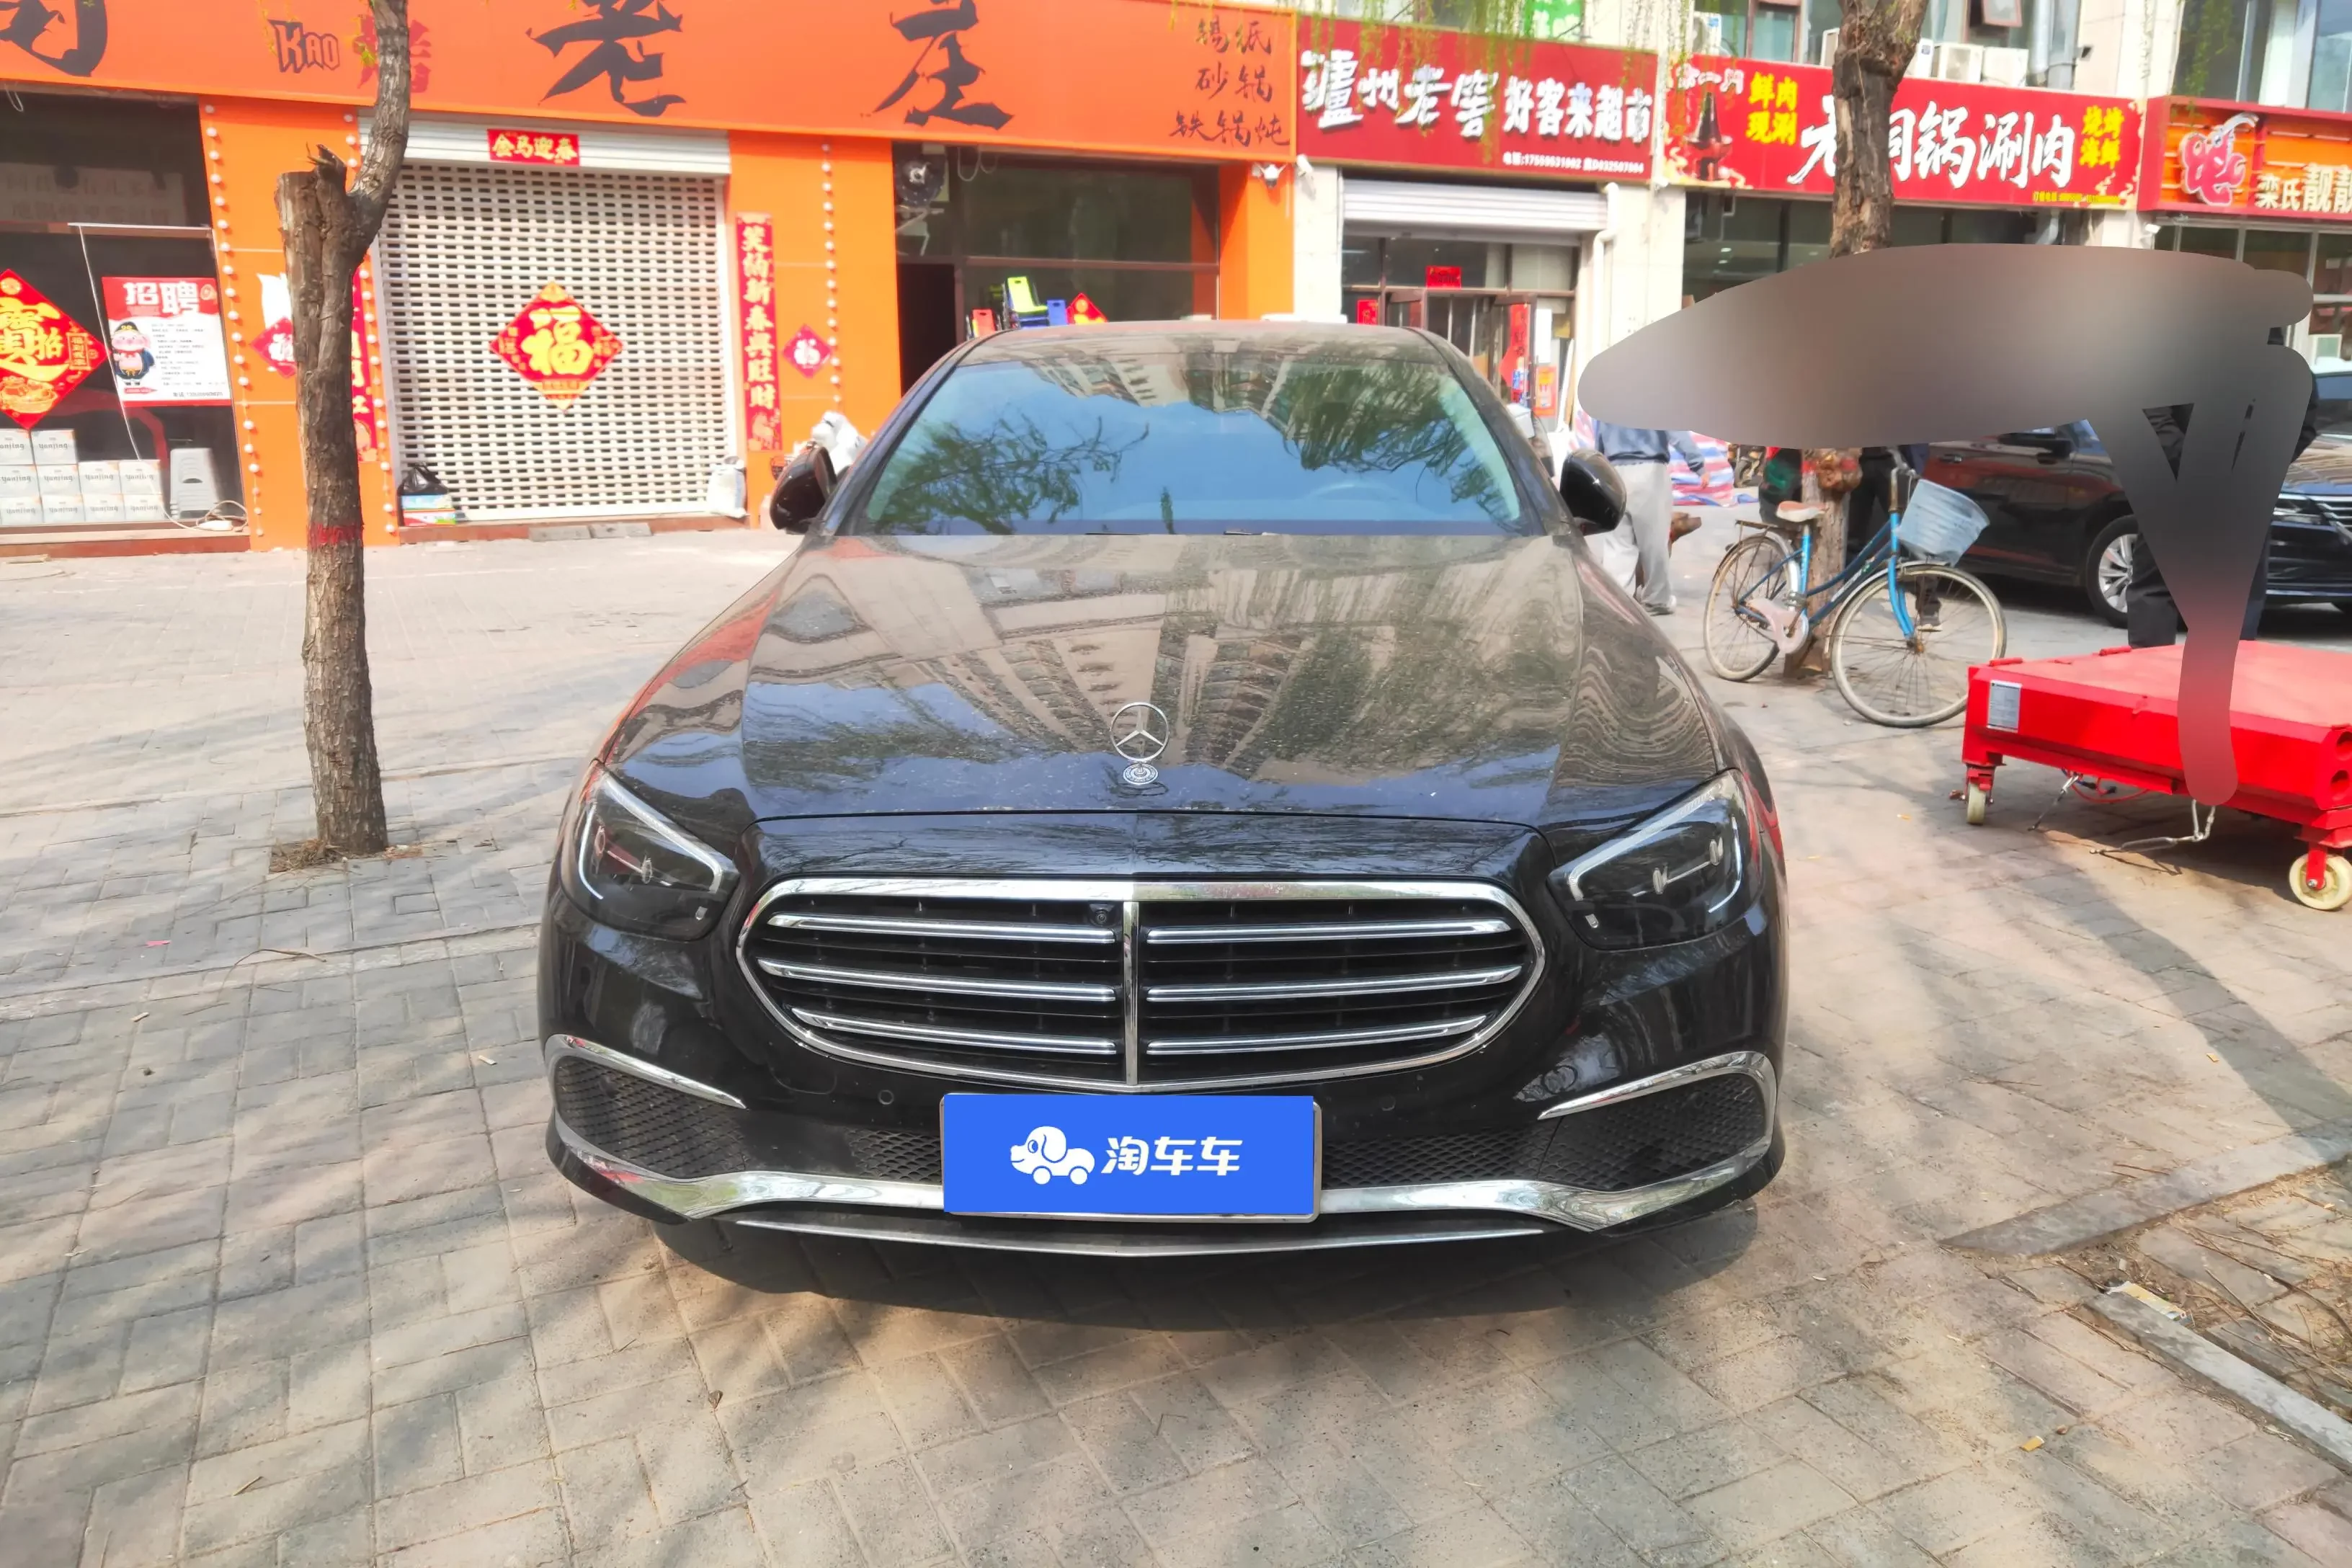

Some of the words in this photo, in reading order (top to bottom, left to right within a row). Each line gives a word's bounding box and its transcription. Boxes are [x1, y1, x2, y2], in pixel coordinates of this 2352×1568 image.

[1502, 75, 1654, 143] 好客来超市
[1748, 71, 1798, 111] 鲜肉
[1746, 110, 1798, 146] 现涮
[2081, 104, 2125, 138] 烧烤
[122, 281, 200, 317] 招聘
[520, 305, 595, 376] 福
